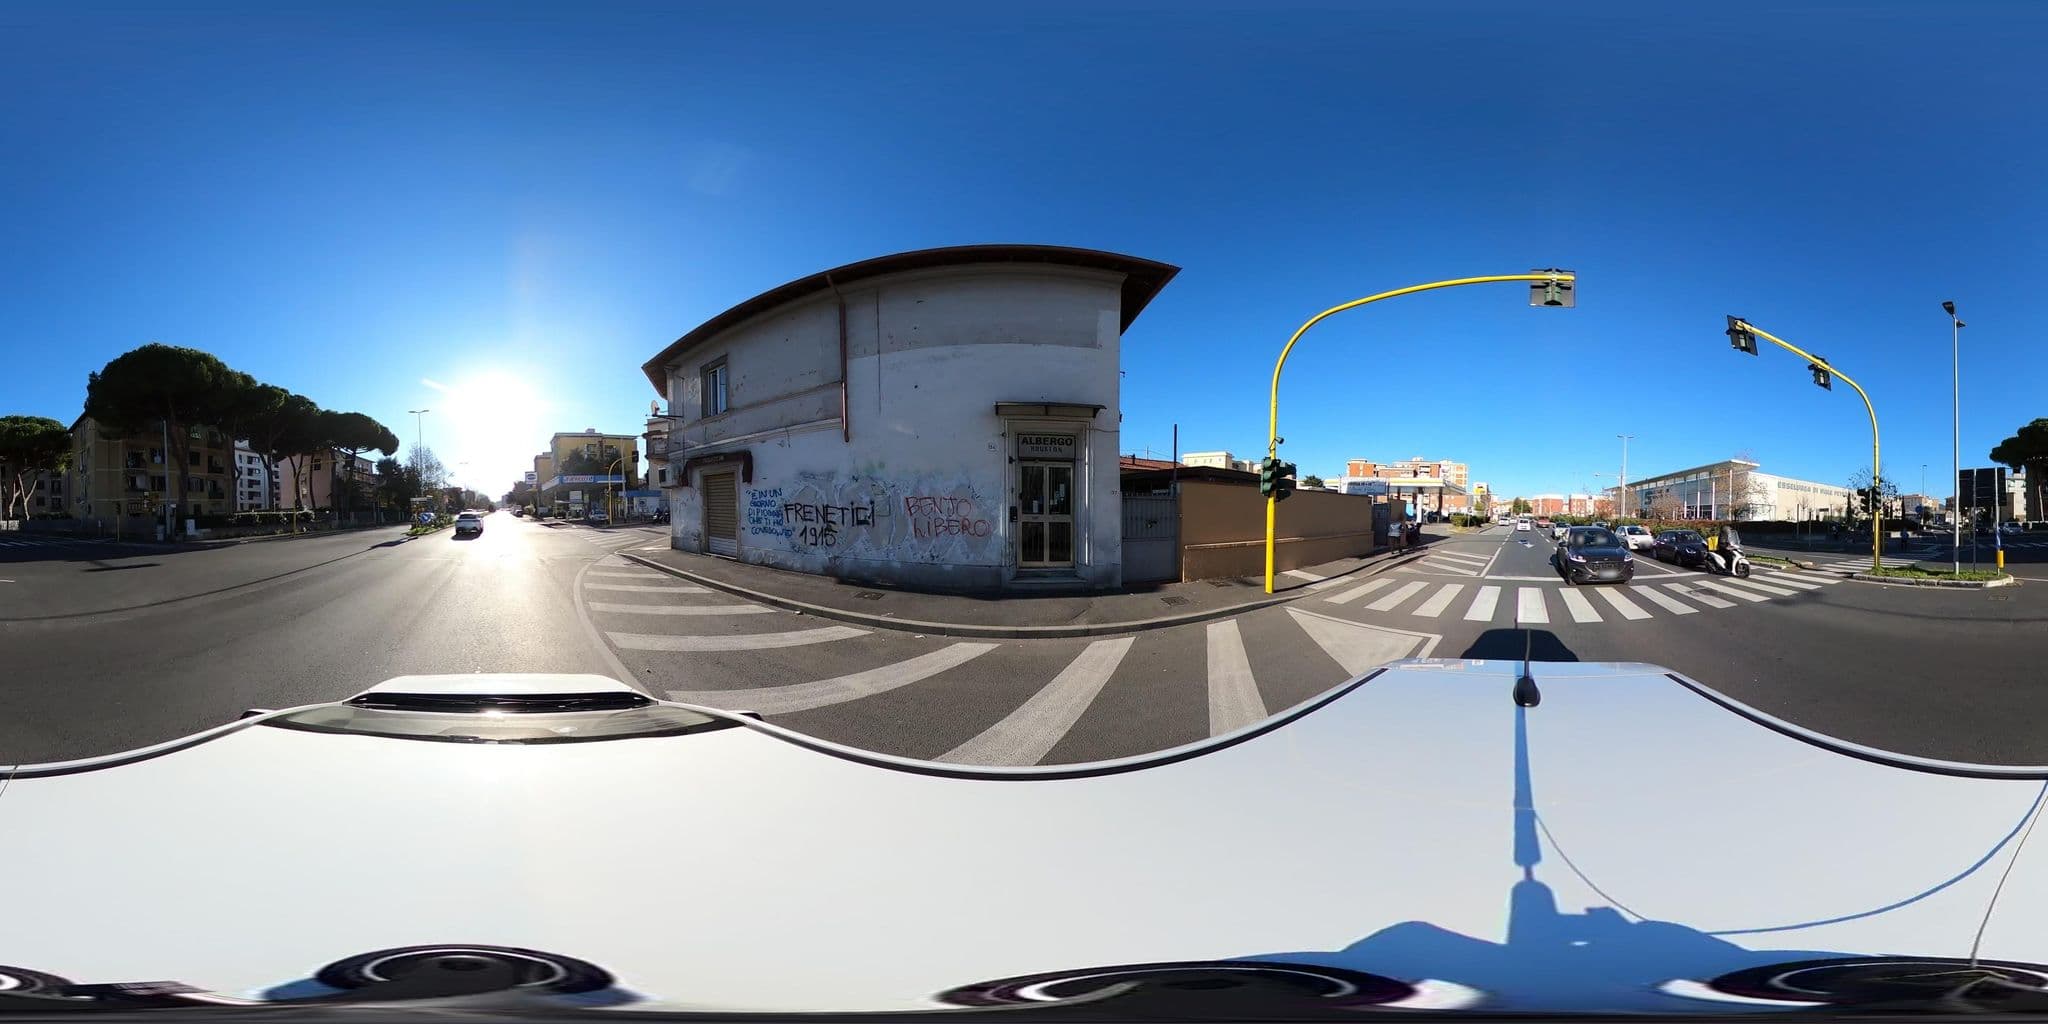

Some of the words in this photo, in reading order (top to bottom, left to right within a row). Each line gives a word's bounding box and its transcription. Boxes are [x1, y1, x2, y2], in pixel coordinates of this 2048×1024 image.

[1021, 436, 1073, 446] ALBERGO
[783, 500, 876, 528] FRENETICI
[799, 525, 838, 547] 1915
